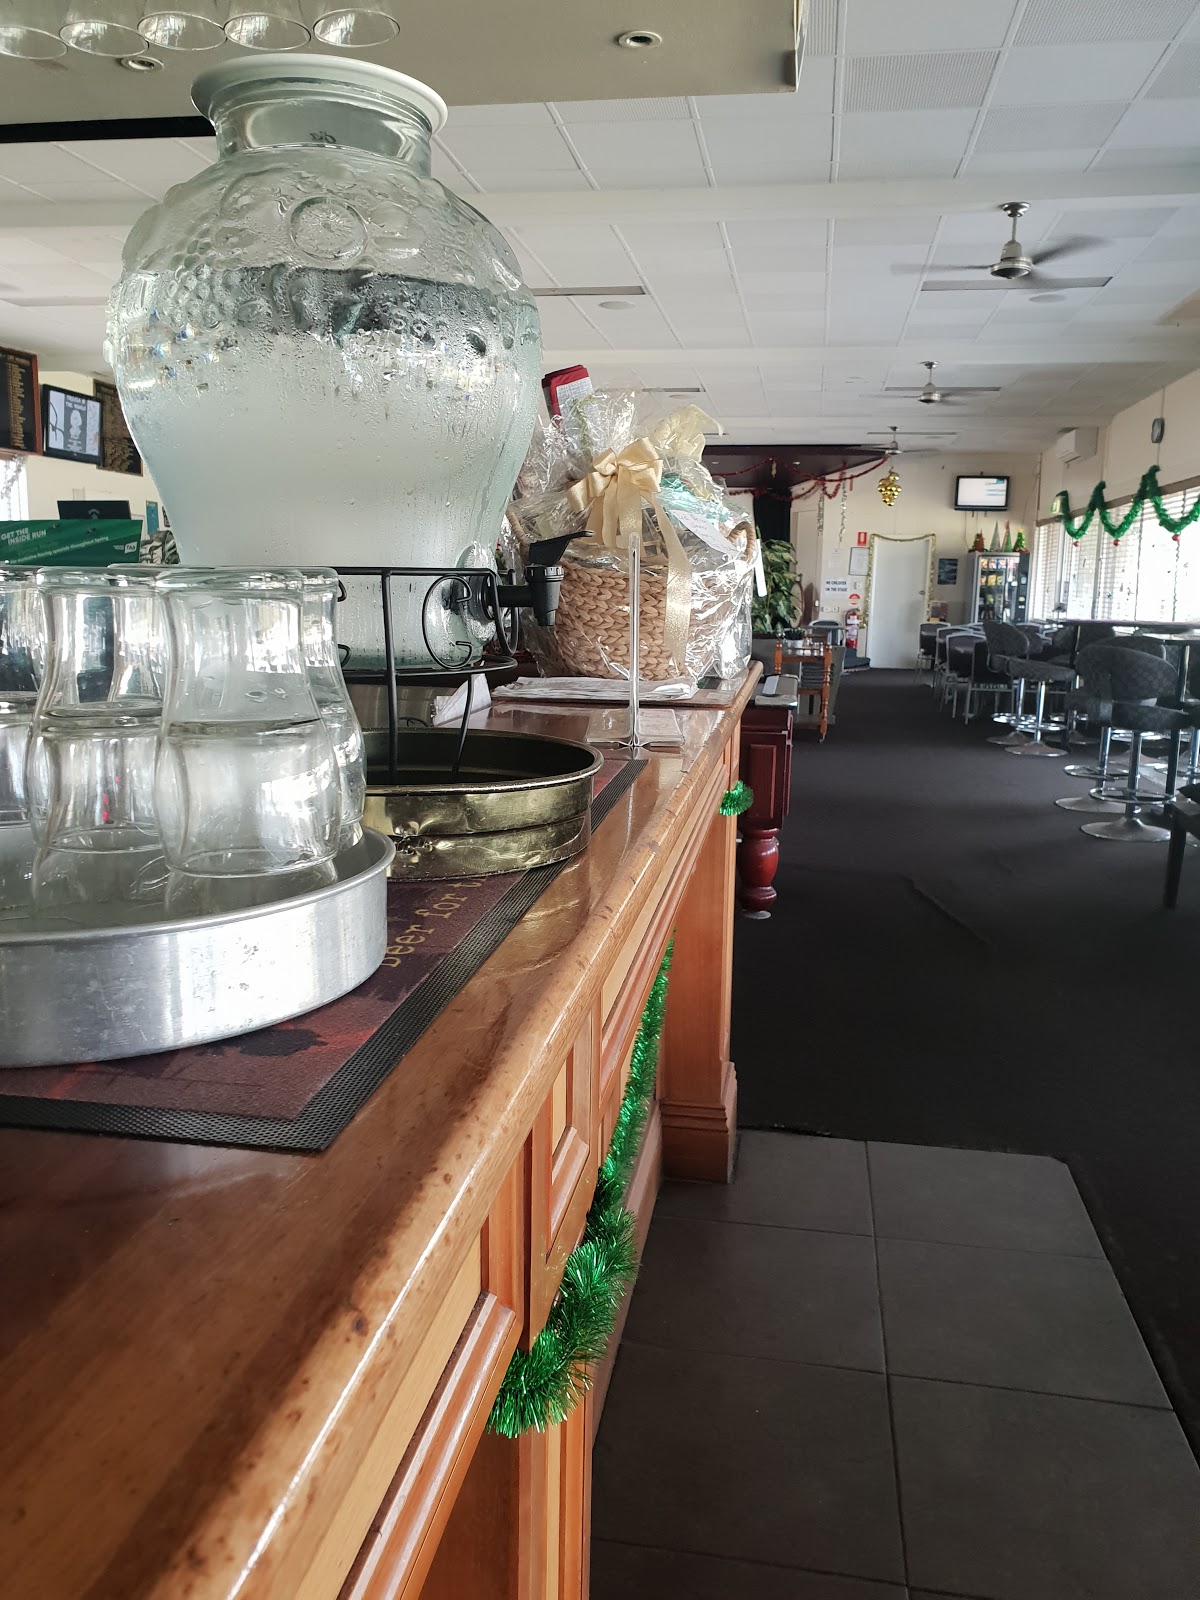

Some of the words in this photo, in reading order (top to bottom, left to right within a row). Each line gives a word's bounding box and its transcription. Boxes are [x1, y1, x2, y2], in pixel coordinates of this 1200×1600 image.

[1, 531, 15, 541] GET
[15, 527, 29, 536] THE
[8, 533, 31, 546] INSIDE
[31, 529, 47, 540] RUN
[414, 893, 468, 919] for
